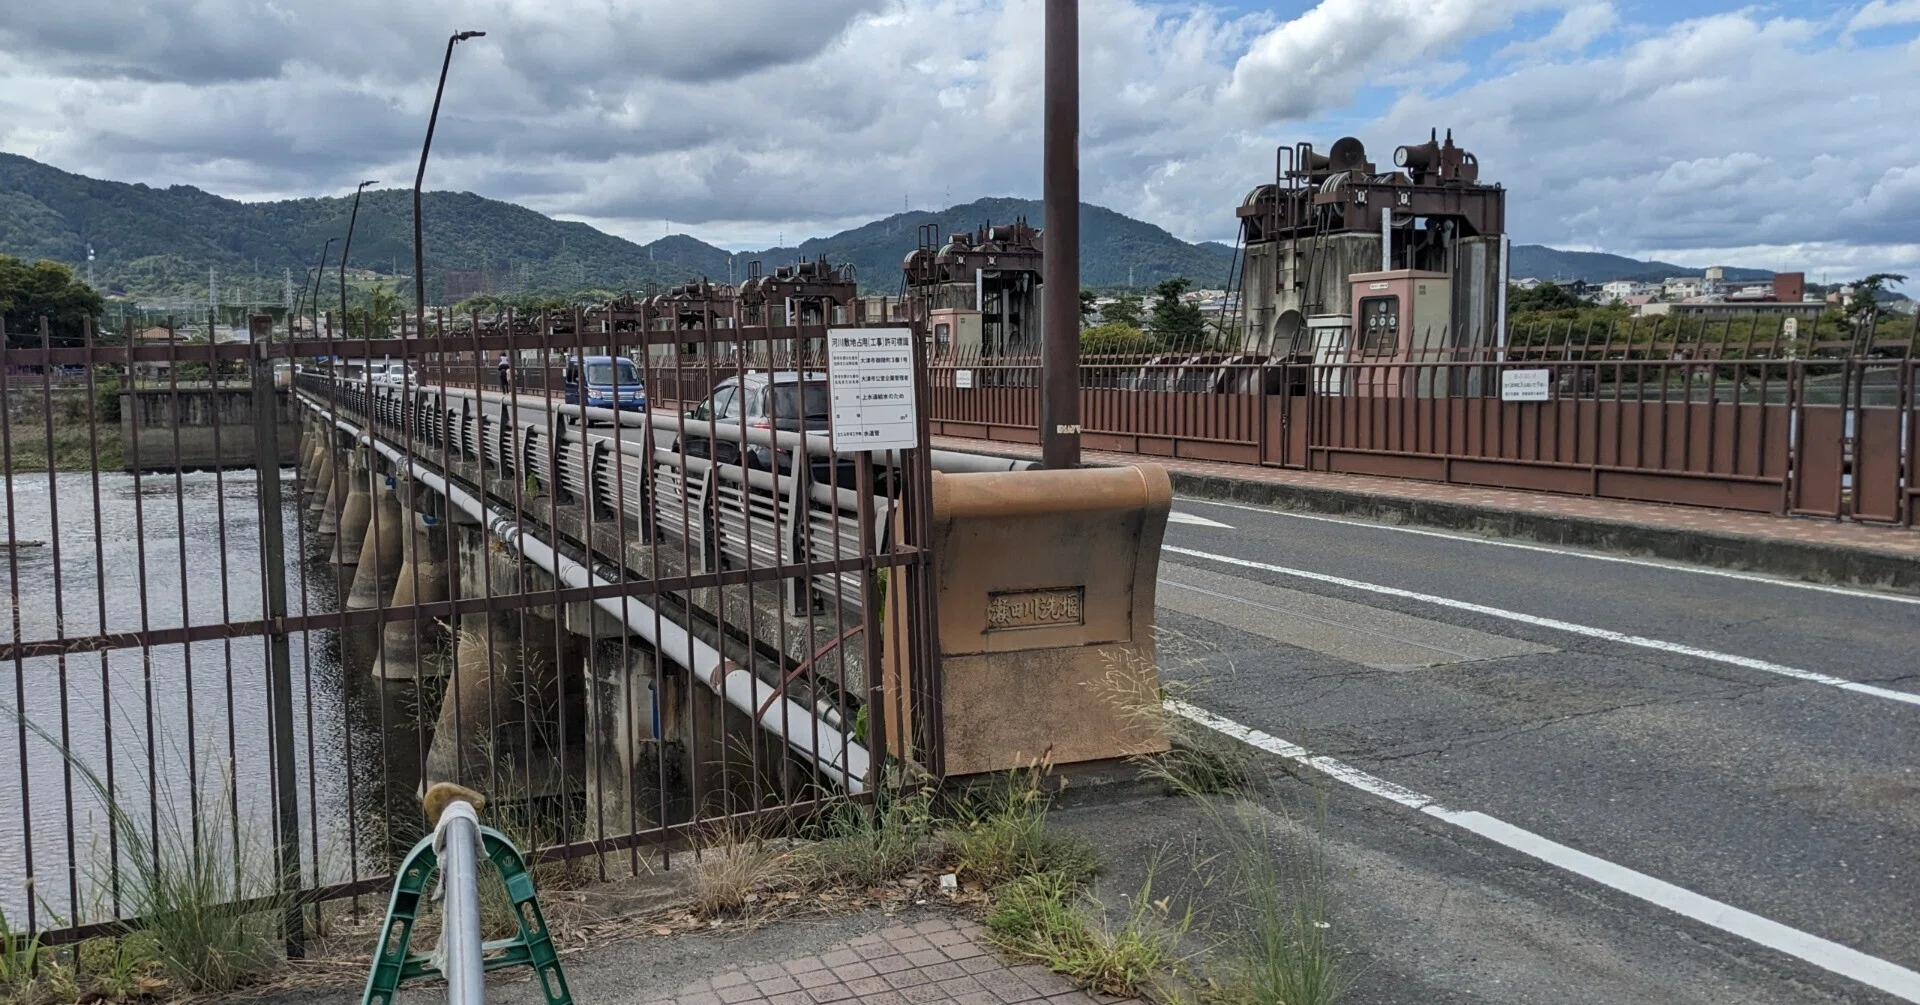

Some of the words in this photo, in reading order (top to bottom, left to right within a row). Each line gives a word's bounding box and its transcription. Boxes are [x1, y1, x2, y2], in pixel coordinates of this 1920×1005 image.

[987, 594, 1080, 625] 瀬田川洗堰
